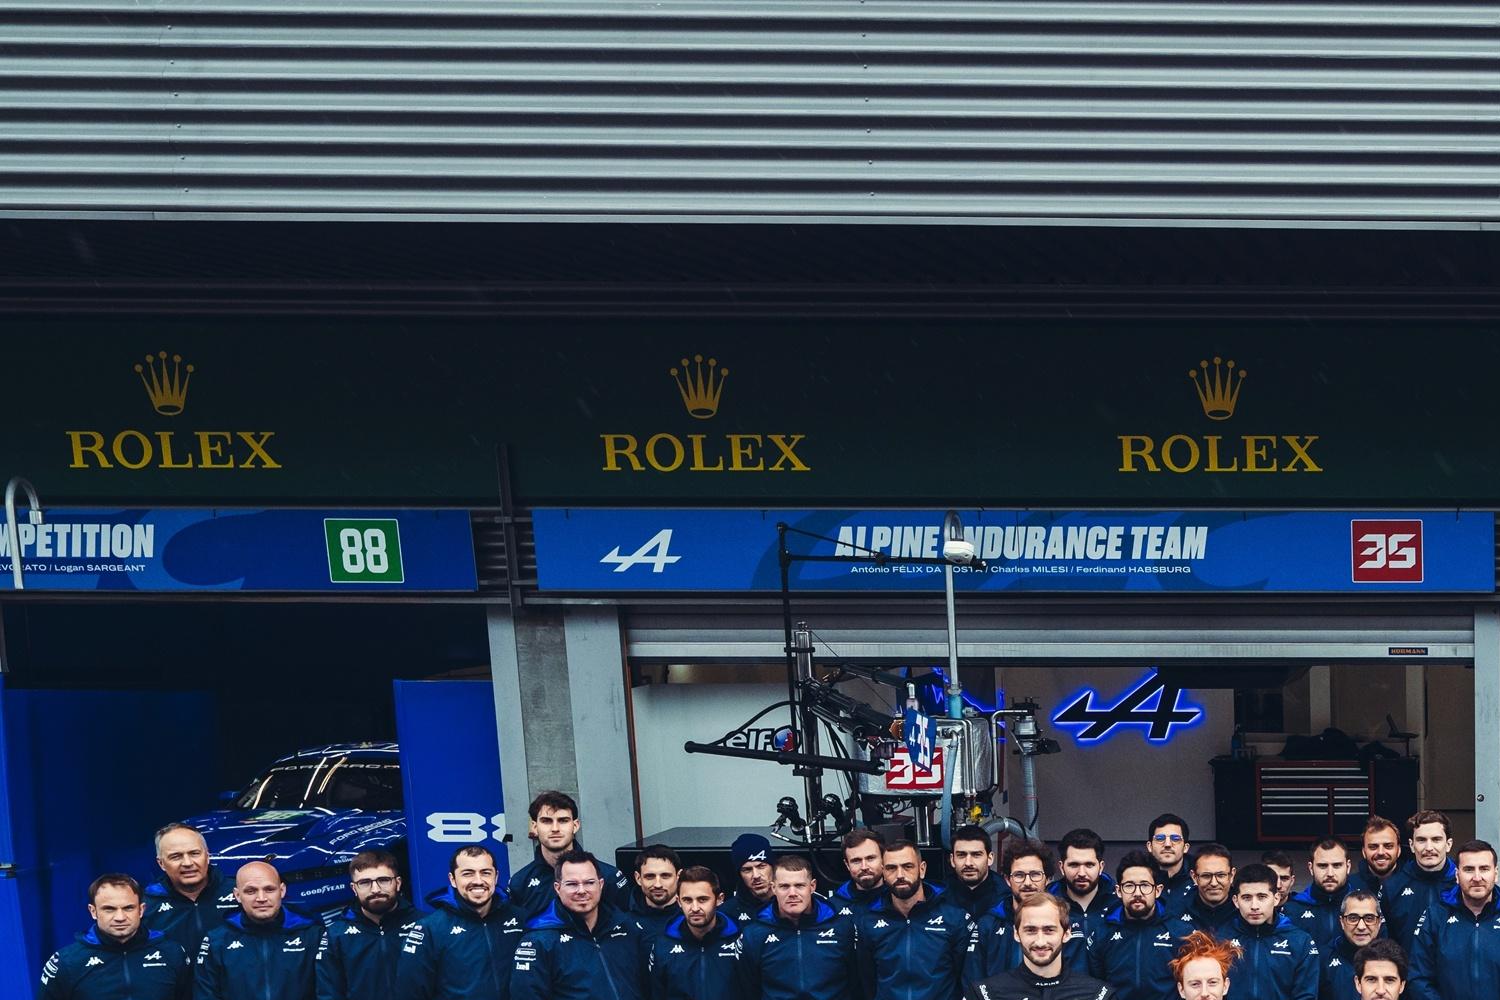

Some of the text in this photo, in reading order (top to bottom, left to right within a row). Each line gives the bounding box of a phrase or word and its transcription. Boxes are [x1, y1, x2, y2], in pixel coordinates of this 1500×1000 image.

[68, 431, 282, 469] ROLEX
[602, 434, 811, 472] ROLEX
[1117, 435, 1324, 473] ROLEX
[339, 528, 389, 573] 88
[834, 526, 1208, 559] ALPINE NDURANCE TEAM
[1358, 534, 1416, 568] 35
[54, 564, 85, 573] Logan
[87, 564, 146, 572] SARGEANT
[850, 565, 890, 573] António
[892, 564, 922, 573] FÉLIX
[991, 565, 1030, 573] Charles
[1076, 565, 1126, 573] Ferdinand
[300, 883, 346, 897] GOODYEAR
